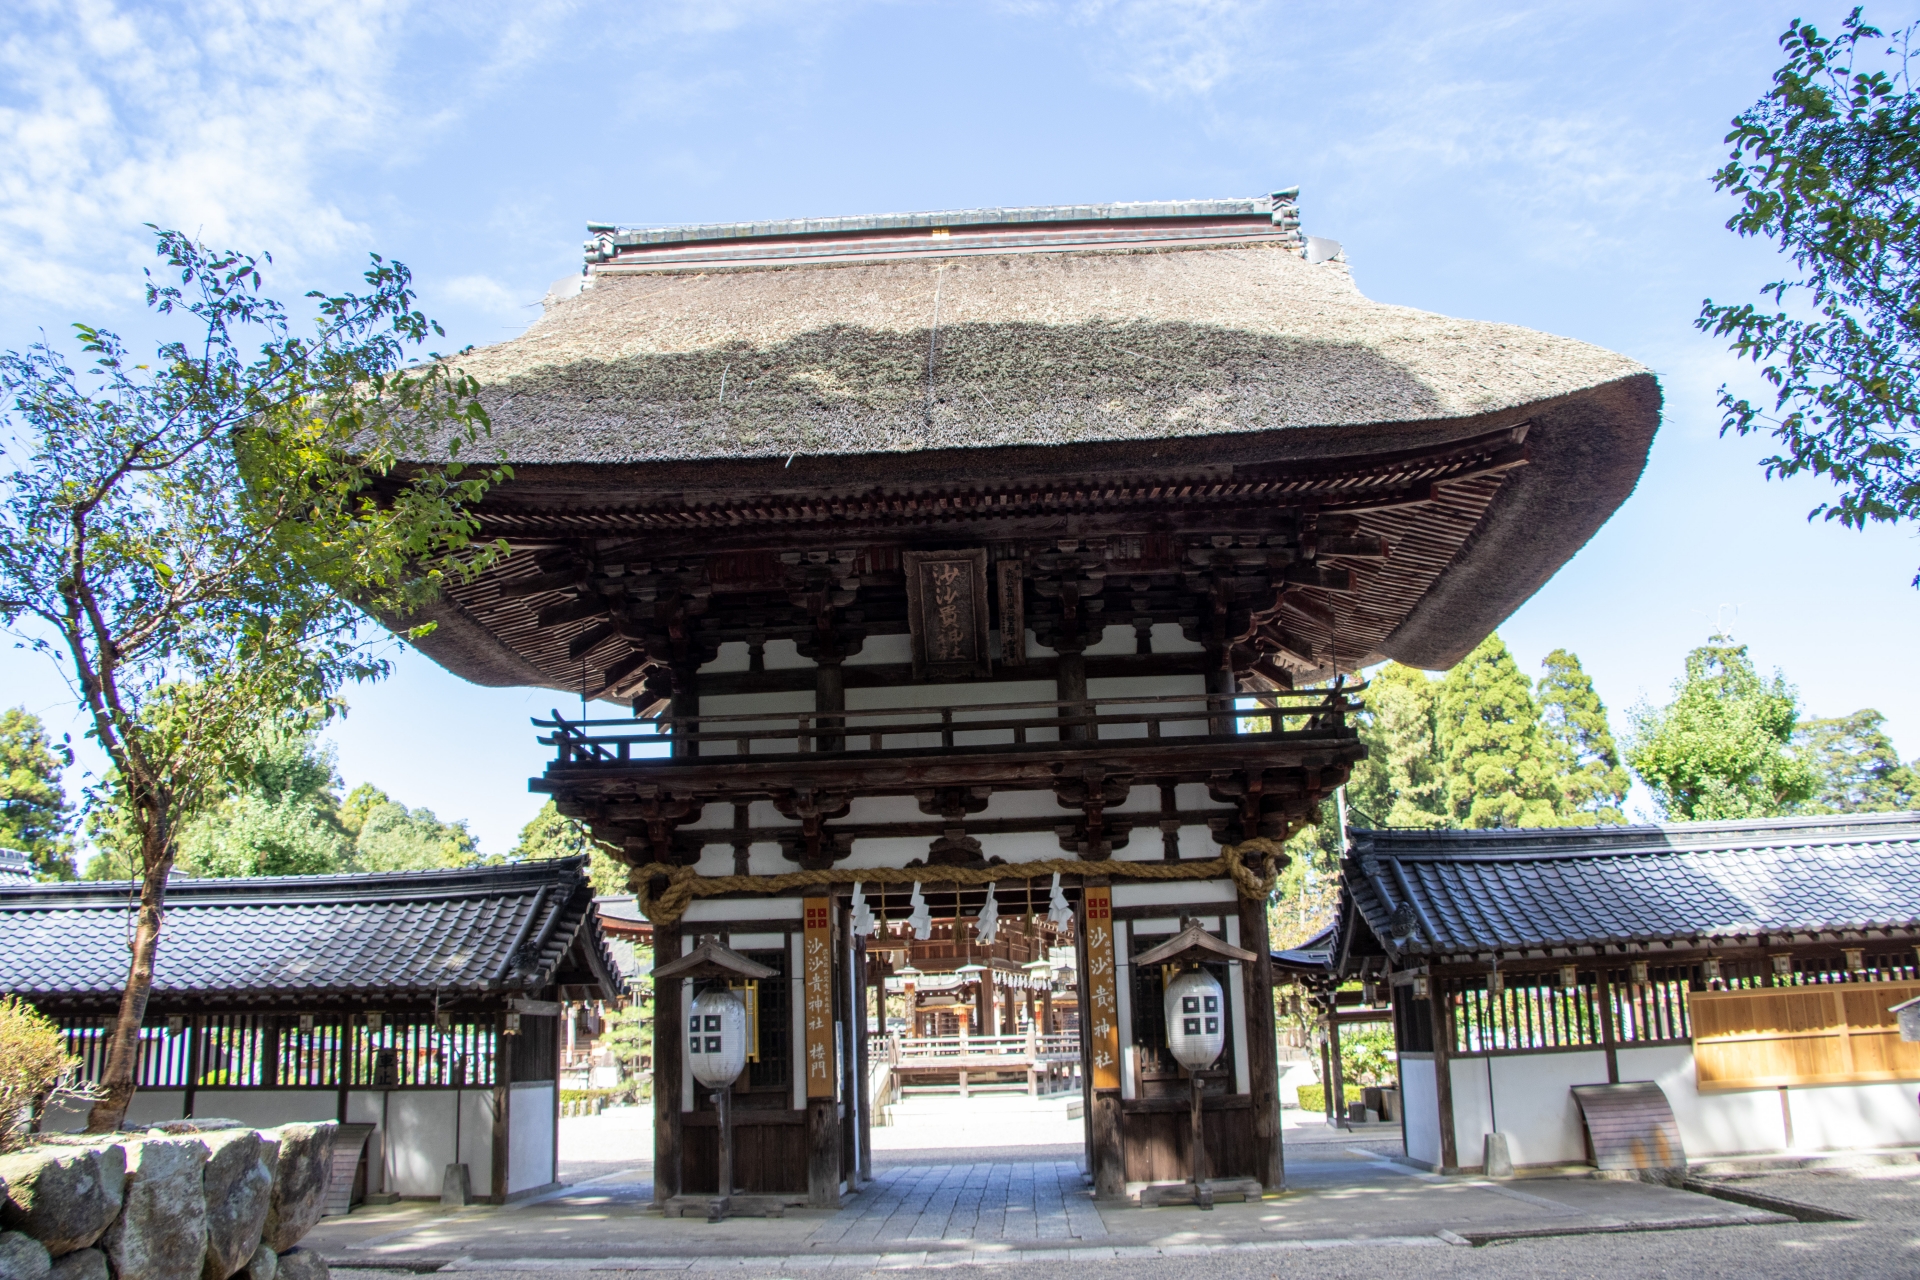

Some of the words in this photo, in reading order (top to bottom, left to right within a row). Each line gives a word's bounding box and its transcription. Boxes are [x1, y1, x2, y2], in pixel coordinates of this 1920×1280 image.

[807, 937, 825, 1031] 沙沙貴神社
[1089, 927, 1114, 1070] 沙沙貴神社
[809, 1042, 827, 1079] 楼門
